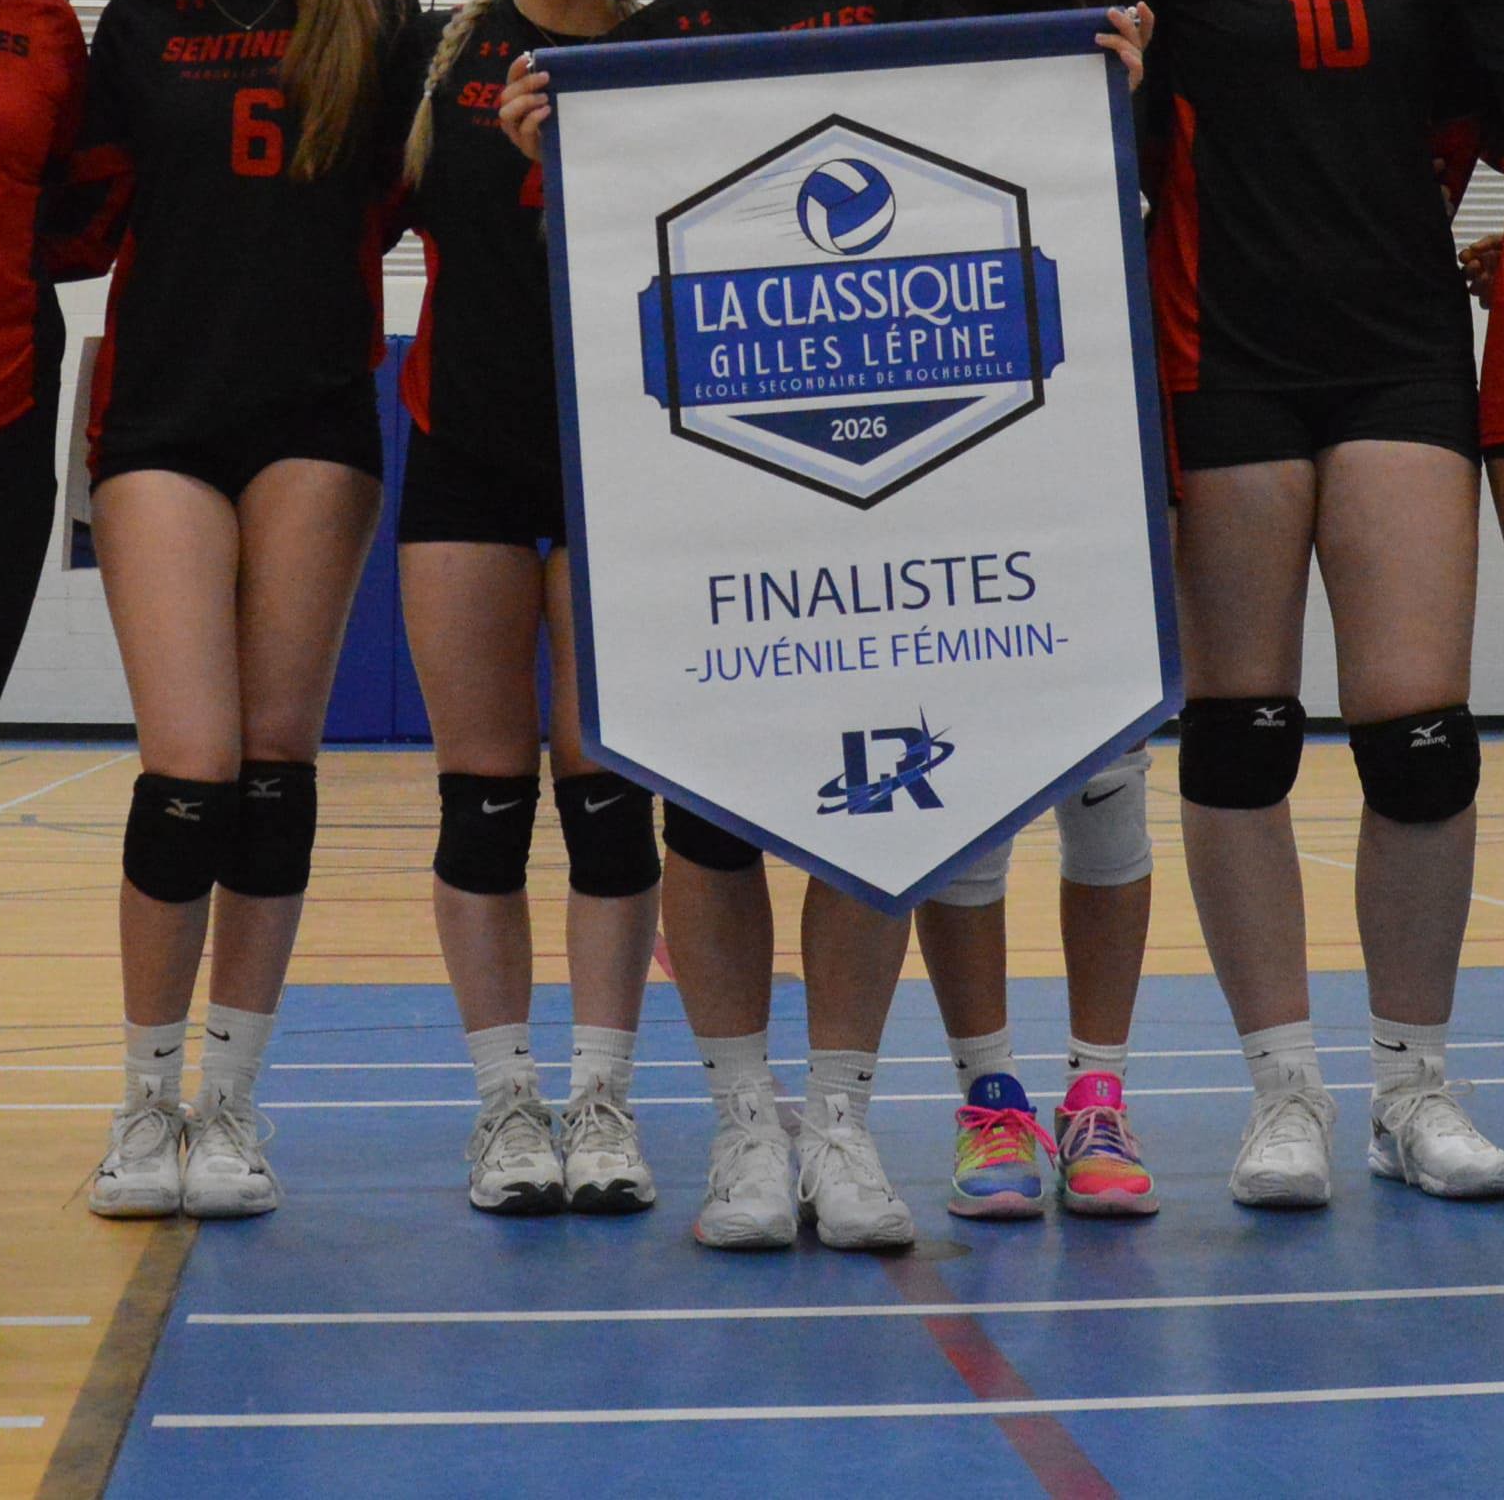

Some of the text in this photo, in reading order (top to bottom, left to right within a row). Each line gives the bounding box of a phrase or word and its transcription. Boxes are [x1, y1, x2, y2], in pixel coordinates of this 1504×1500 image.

[161, 29, 294, 64] SENTINE
[231, 87, 285, 178] 6
[693, 260, 1007, 333] LA CLASSIQUE
[710, 322, 997, 379] GILLES LÉPINE
[694, 360, 1015, 399] ÉCOLE SECONDAIRE DE ROCHEBELLE
[830, 416, 888, 442] 2026
[708, 551, 1037, 626] FINALISTES
